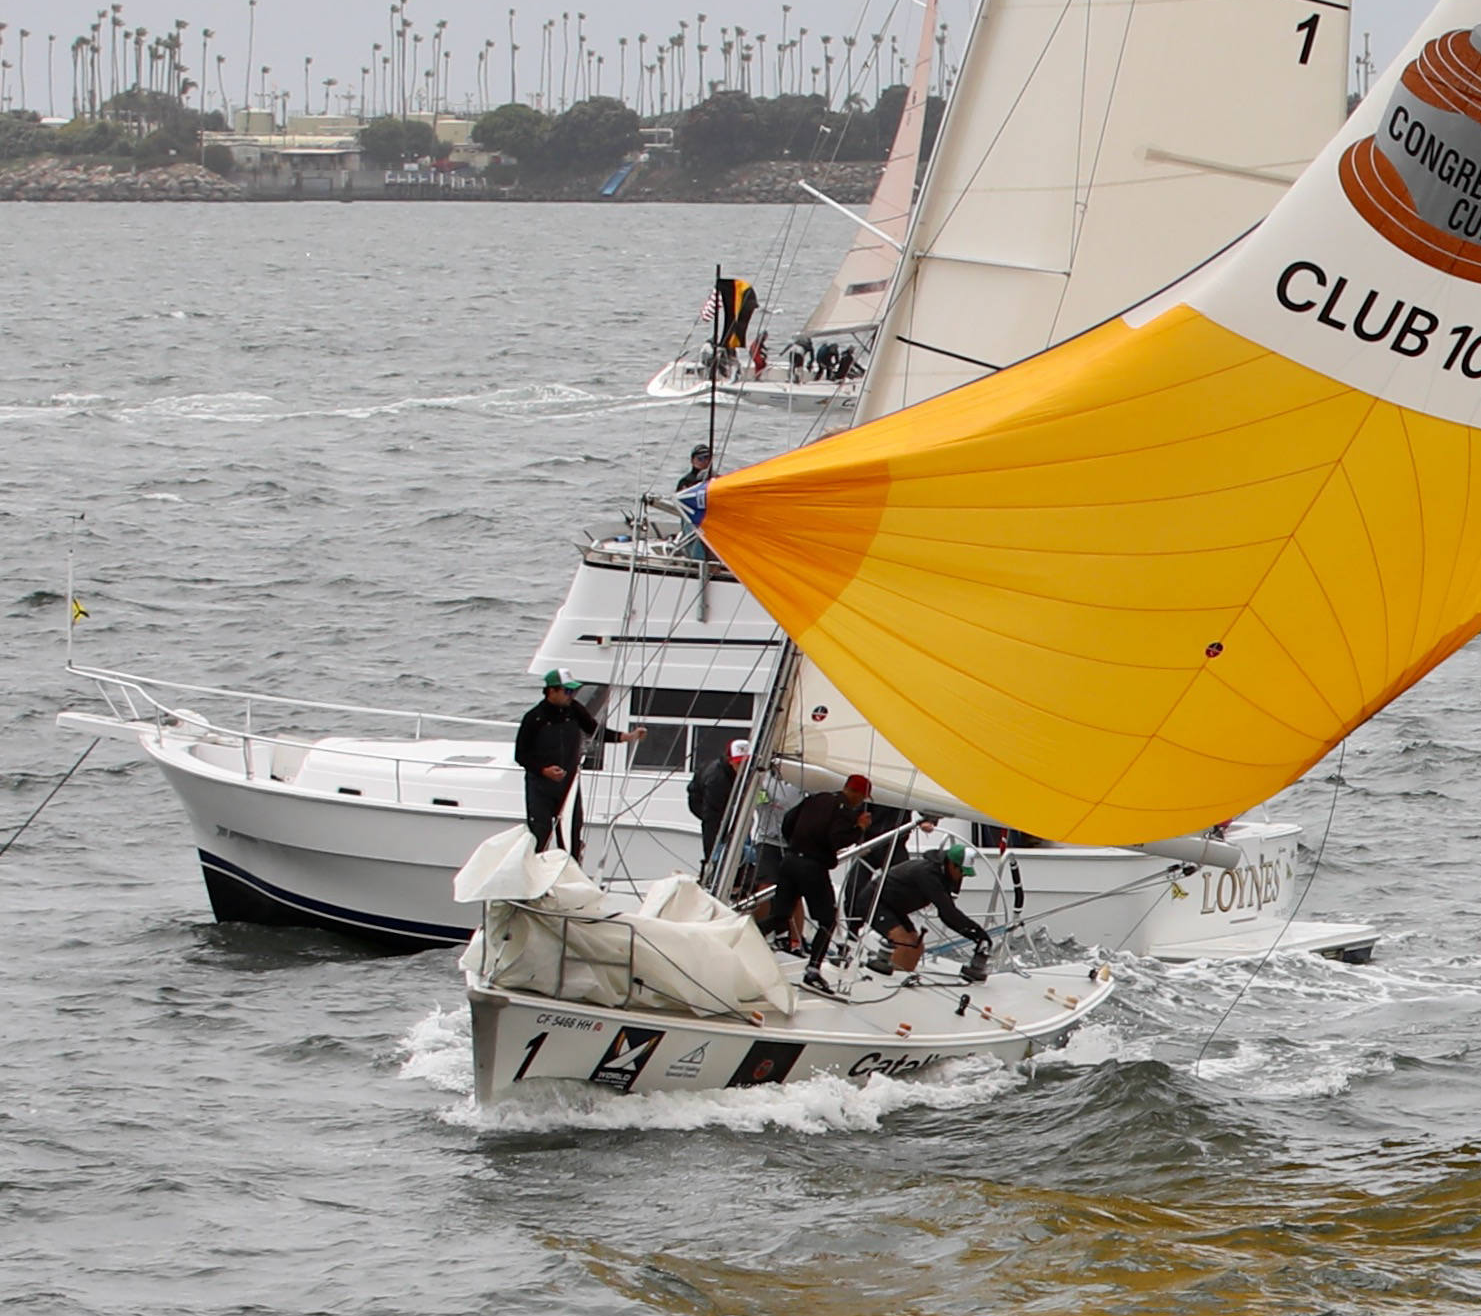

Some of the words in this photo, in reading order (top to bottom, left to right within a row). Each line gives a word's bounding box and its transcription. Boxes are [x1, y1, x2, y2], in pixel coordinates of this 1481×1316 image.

[1296, 13, 1320, 65] 1
[1276, 261, 1439, 357] CLUB
[1201, 859, 1281, 915] LOYNES
[537, 1013, 551, 1025] CF
[513, 1032, 549, 1083] 1
